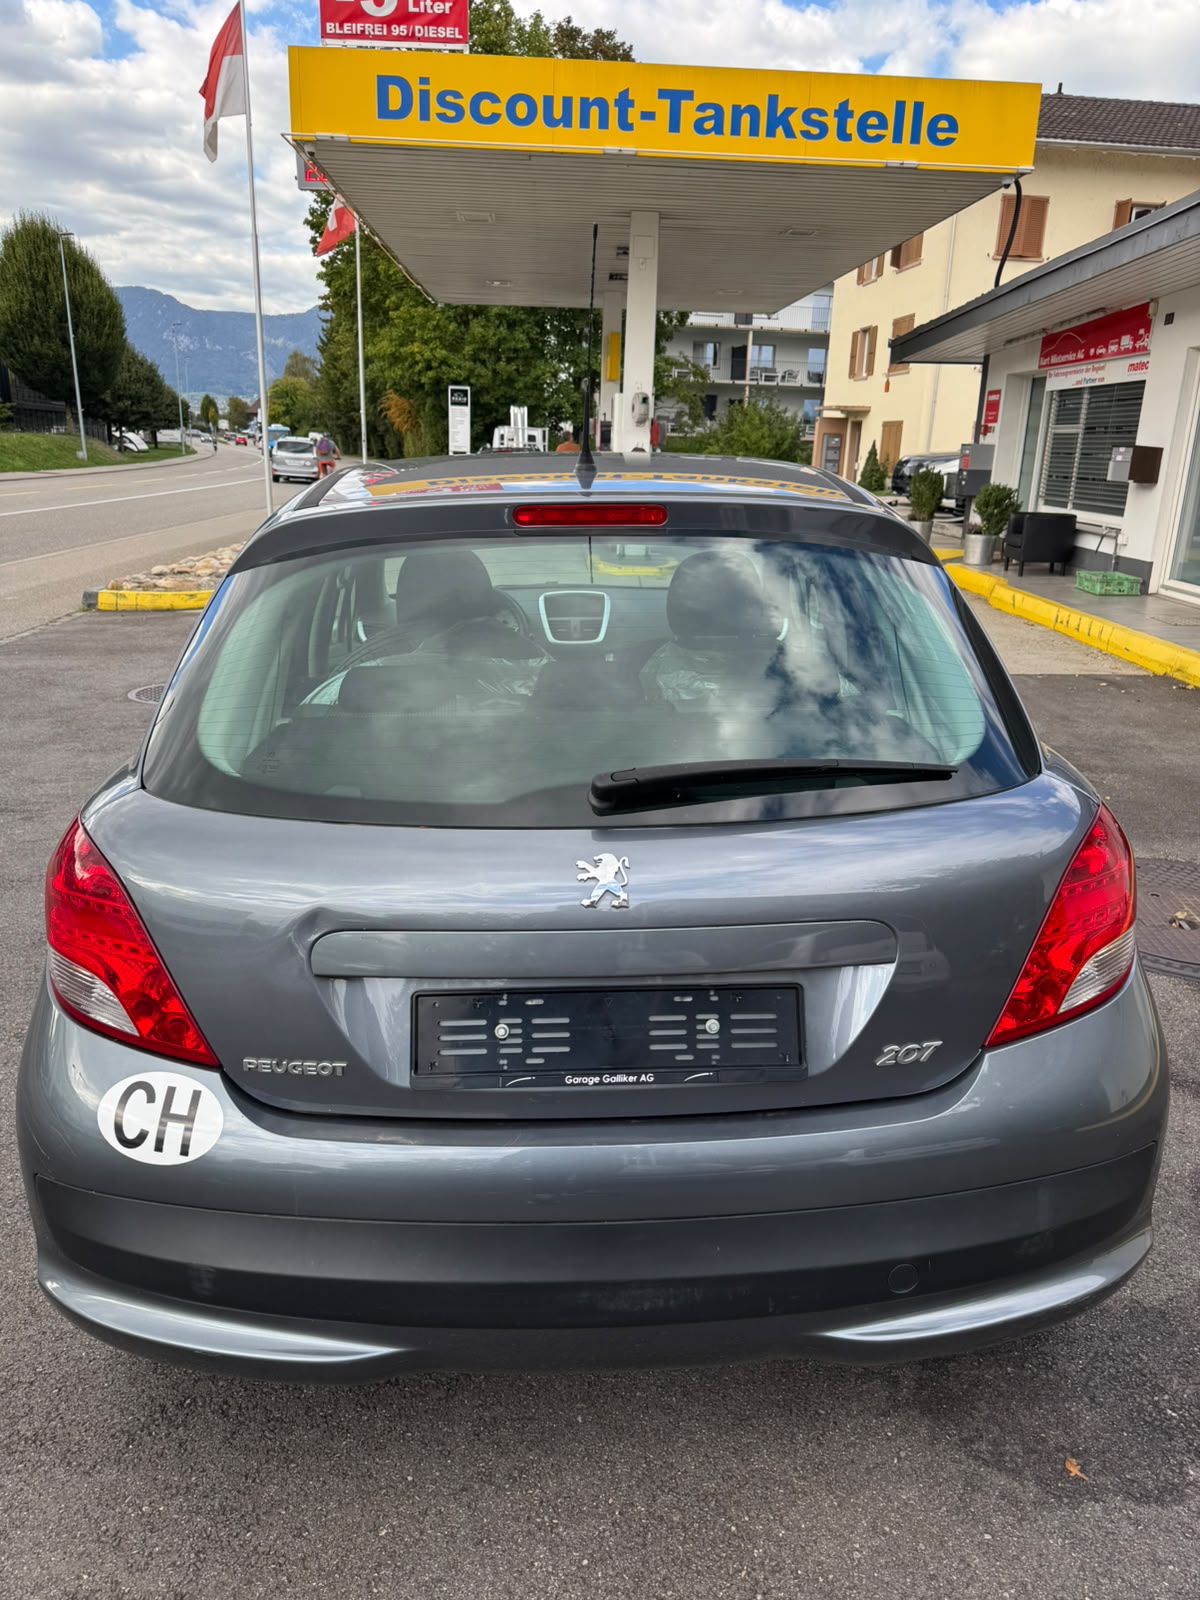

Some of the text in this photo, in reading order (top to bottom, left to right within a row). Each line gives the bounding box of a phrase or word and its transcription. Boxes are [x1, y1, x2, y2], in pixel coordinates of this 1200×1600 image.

[407, 0, 453, 14] Liter
[324, 22, 388, 36] BLEIFREI
[376, 74, 959, 147] Discount-Tankstelle
[1076, 349, 1085, 360] AG
[1127, 360, 1150, 373] matec
[1083, 377, 1097, 385] Partner
[874, 1041, 943, 1066] 207
[242, 1057, 348, 1077] PEUGEOT
[564, 1073, 655, 1086] Garage Galliker AG
[114, 1080, 202, 1157] CH
